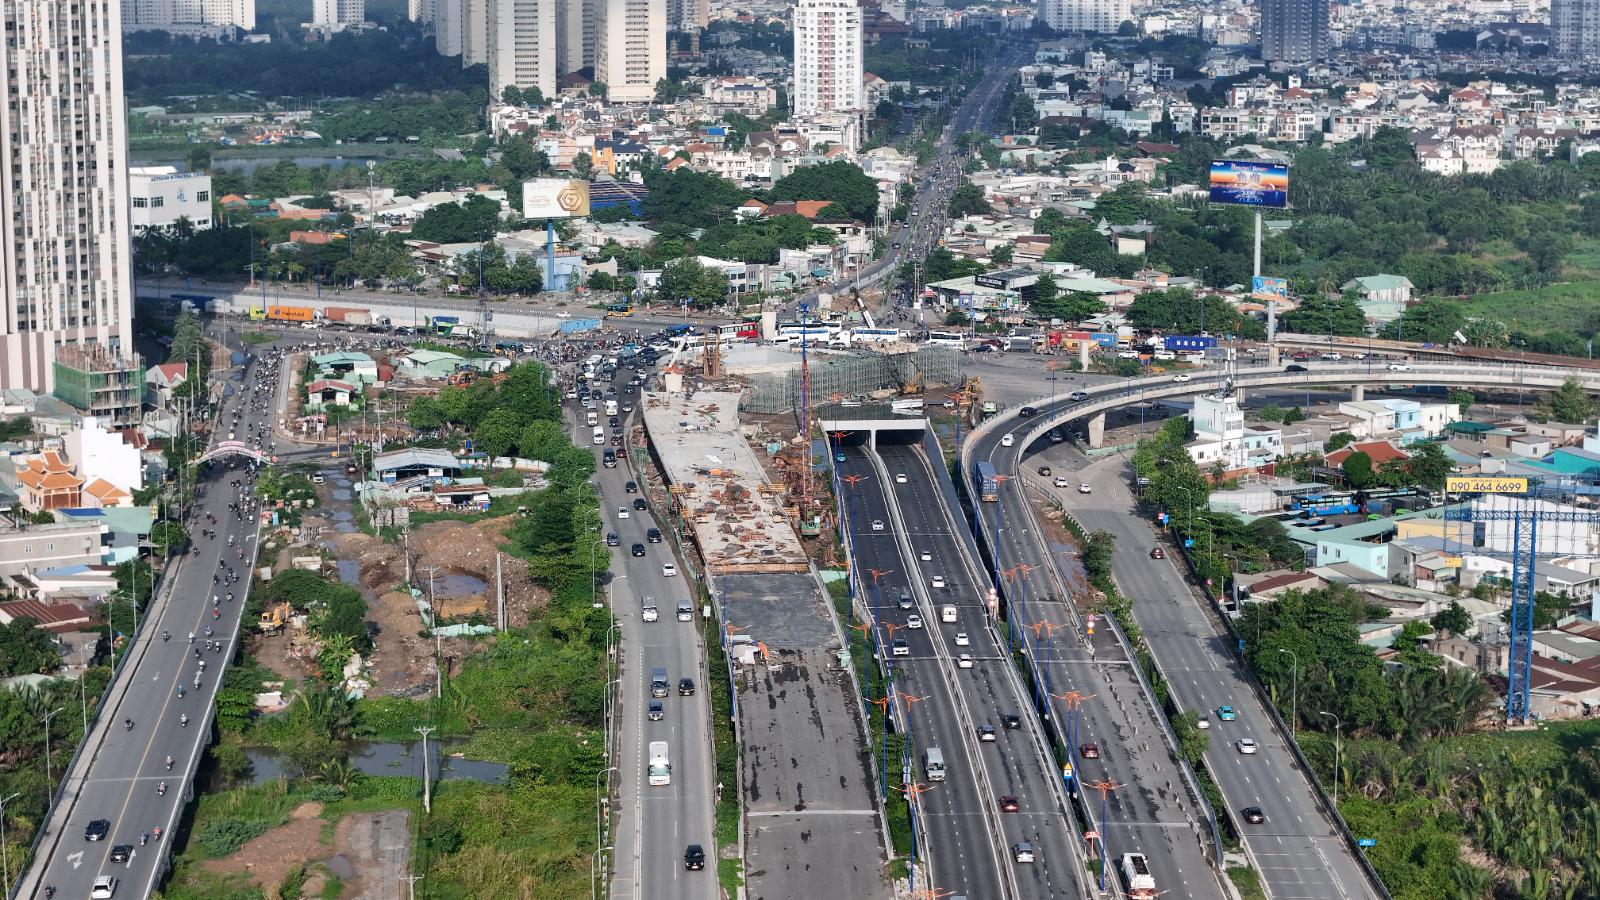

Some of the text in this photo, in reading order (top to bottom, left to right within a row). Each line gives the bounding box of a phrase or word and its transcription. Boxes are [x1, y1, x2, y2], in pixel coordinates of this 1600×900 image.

[1451, 482, 1521, 491] 090 464 6699
